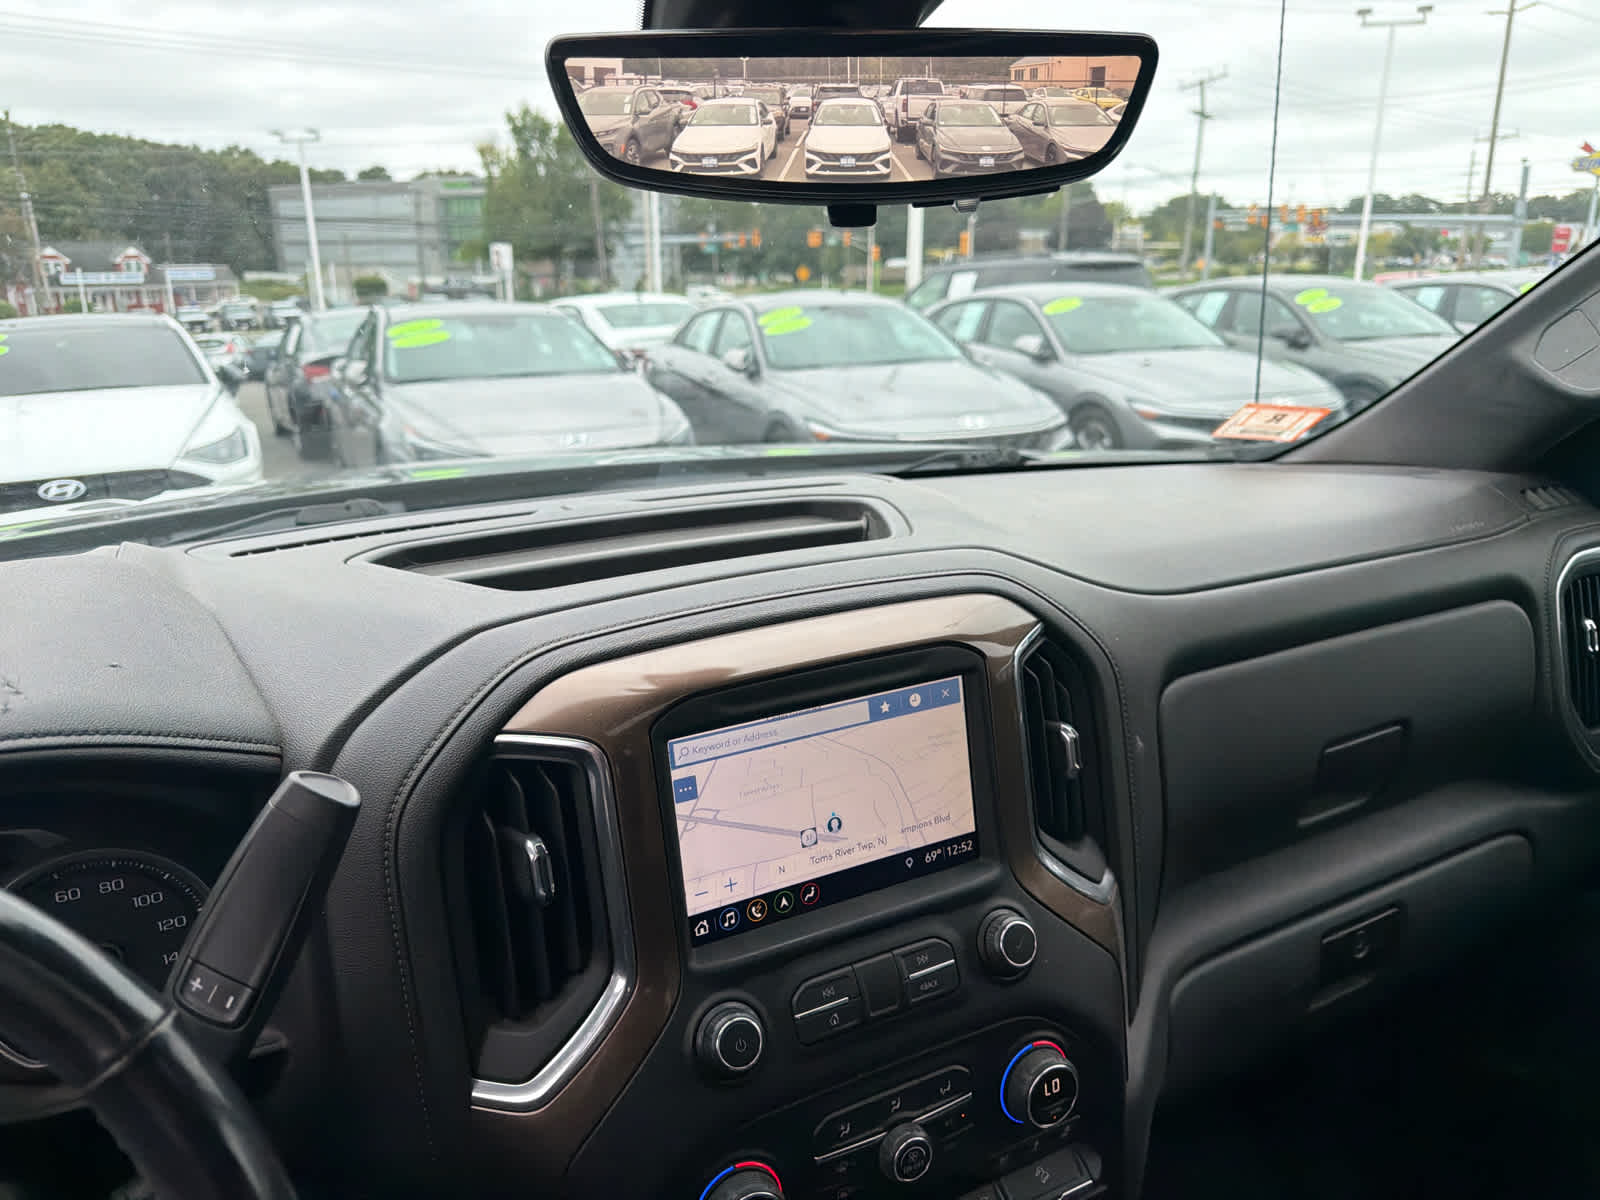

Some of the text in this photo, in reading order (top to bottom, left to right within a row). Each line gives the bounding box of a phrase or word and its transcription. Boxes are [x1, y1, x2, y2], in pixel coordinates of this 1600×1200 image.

[692, 738, 730, 755] Keyword
[743, 729, 778, 743] Address
[934, 812, 951, 824] Blvd
[810, 854, 833, 865] Toms
[835, 847, 855, 858] River
[878, 835, 888, 846] NJ
[947, 839, 973, 857] 12:52
[99, 879, 124, 893] 80
[55, 888, 81, 902] 60
[132, 892, 163, 908] 100
[157, 915, 187, 931] 120
[163, 951, 179, 965] 14
[1044, 1077, 1060, 1096] LO
